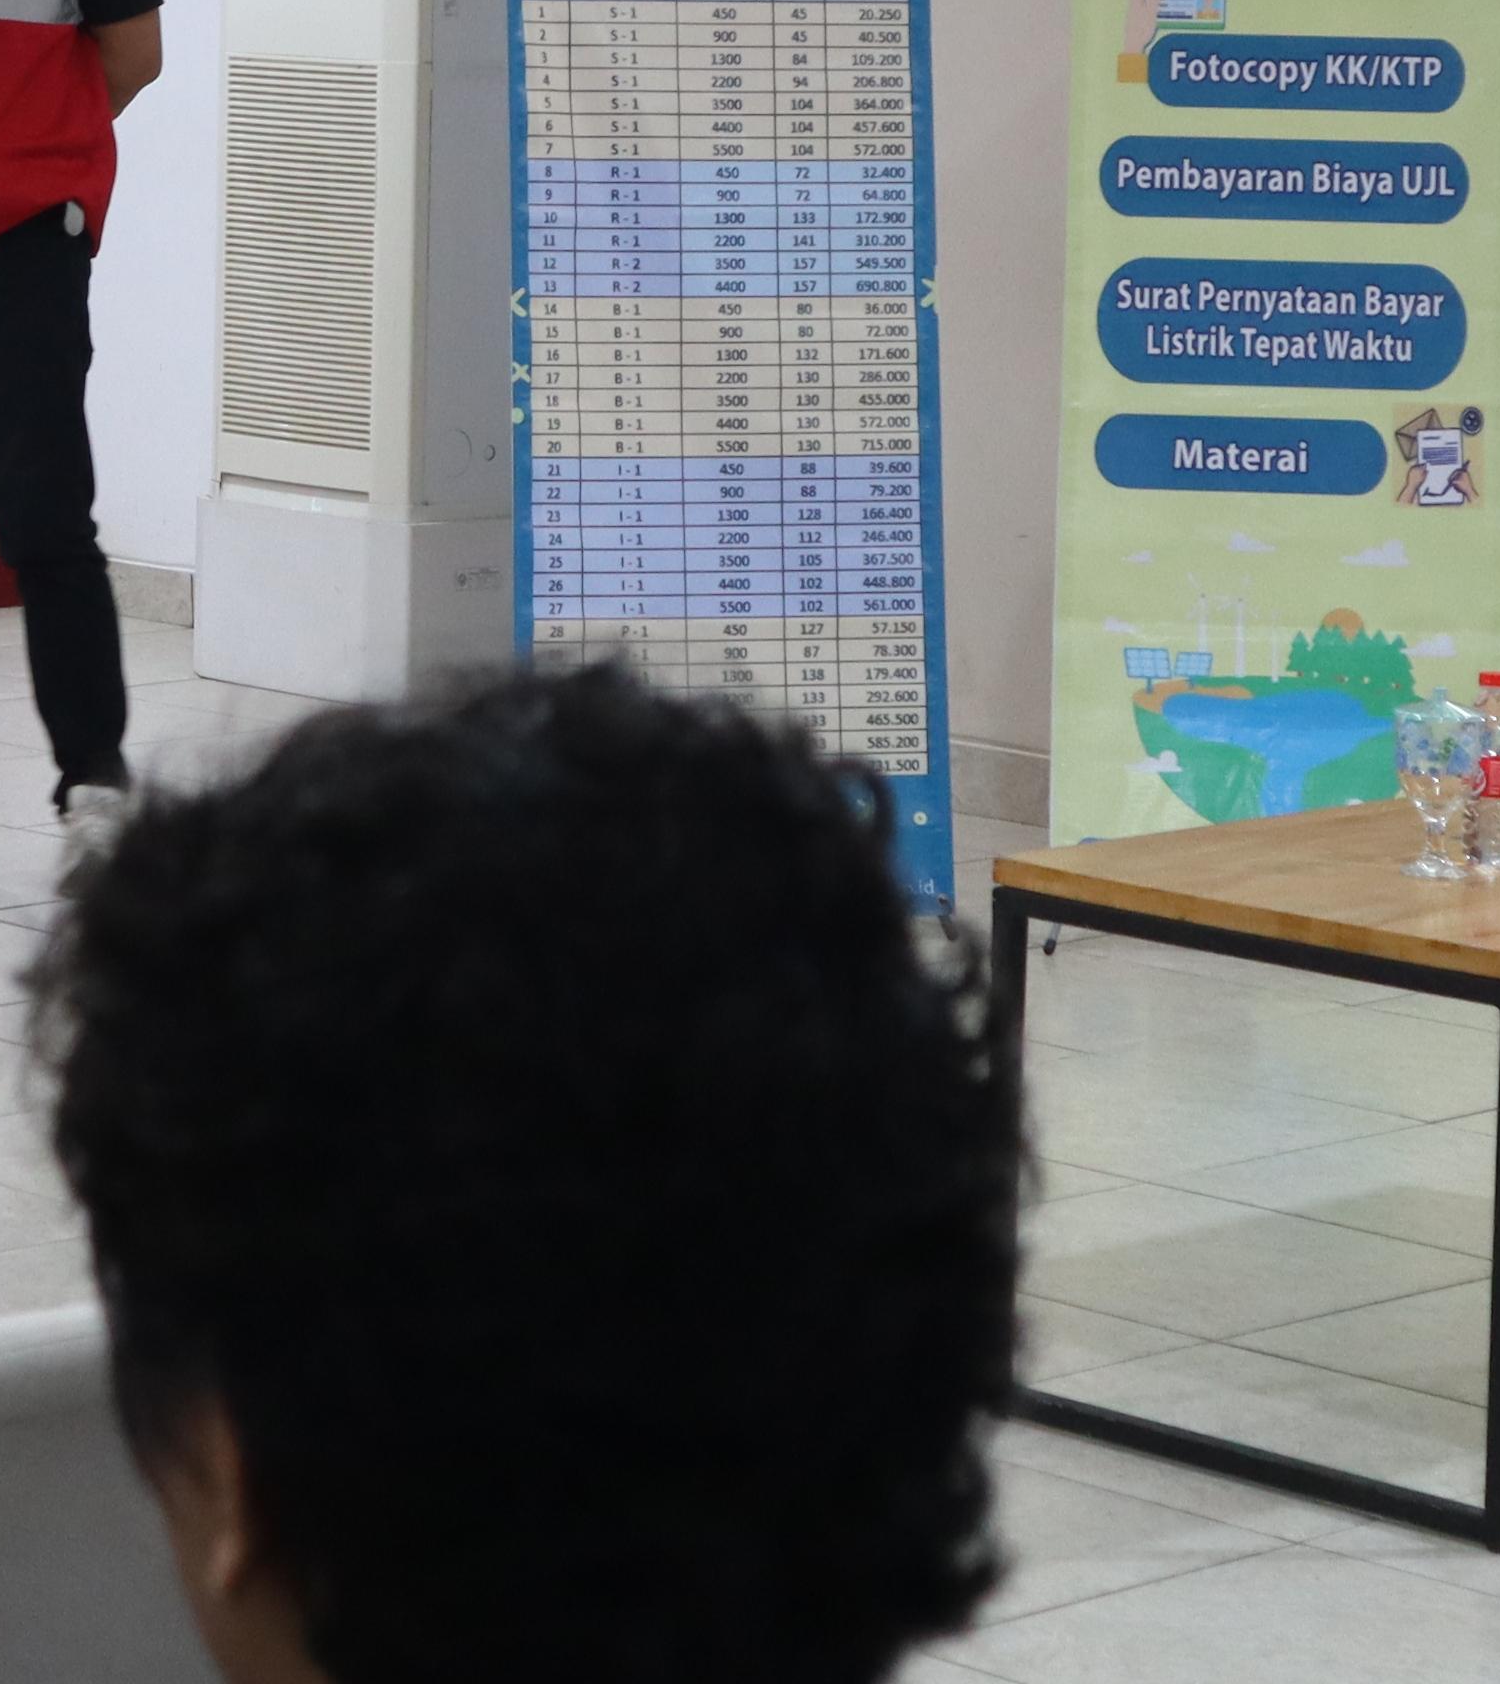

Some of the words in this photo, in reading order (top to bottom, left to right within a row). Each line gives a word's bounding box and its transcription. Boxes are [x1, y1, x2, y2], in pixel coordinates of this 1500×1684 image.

[713, 8, 736, 19] 450
[792, 9, 807, 19] 45
[860, 9, 901, 20] 20.250
[712, 54, 741, 65] 1300
[793, 54, 807, 65] 84
[853, 54, 902, 66] 109.200
[1170, 50, 1318, 92] Fotocopy
[1325, 54, 1443, 87] KK/KTP
[712, 76, 742, 88] 2200
[793, 77, 808, 87] 94
[854, 76, 903, 87] 206.800
[714, 99, 742, 110] 3500
[792, 99, 813, 110] 104
[855, 99, 903, 110] 364.000
[713, 145, 743, 156] 5500
[792, 145, 813, 156] 104
[855, 144, 905, 156] 572.000
[716, 167, 739, 179] 450
[796, 167, 809, 179] 72
[863, 167, 905, 178] 32.400
[1117, 158, 1304, 198] Pembayaran
[1312, 162, 1393, 203] Biaya
[1402, 165, 1456, 197] UJL
[716, 213, 745, 224] 1300
[794, 212, 815, 224] 133
[857, 212, 906, 223] 172.900
[715, 235, 745, 247] 2200
[794, 235, 815, 246] 141
[857, 235, 905, 246] 310.200
[715, 281, 745, 292] 4400
[795, 281, 816, 292] 157
[856, 281, 906, 292] 690.800
[1116, 278, 1191, 311] Surat
[1198, 281, 1357, 321] Pernyataan
[1364, 285, 1445, 325] Bayar
[720, 327, 742, 338] 900
[798, 326, 813, 337] 80
[867, 326, 908, 337] 72.000
[1146, 325, 1235, 357] Listrik
[1241, 327, 1318, 367] Tepat
[1325, 329, 1413, 363] Waktu
[717, 349, 747, 361] 1300
[797, 349, 818, 360] 132
[860, 348, 909, 360] 171.600
[718, 395, 748, 407] 3500
[797, 395, 819, 406] 130
[859, 394, 910, 405] 455.000
[717, 441, 748, 452] 5500
[798, 440, 821, 451] 130
[862, 439, 911, 450] 715.000
[1173, 439, 1309, 473] Materai
[720, 486, 744, 498] 900
[801, 486, 816, 497] 88
[870, 485, 911, 496] 79.200
[718, 510, 749, 521] 1300
[799, 509, 821, 520] 128
[863, 508, 912, 519] 166.400
[719, 532, 749, 544] 2200
[800, 532, 821, 543] 112
[863, 530, 912, 542] 246.400
[719, 578, 750, 590] 4400
[800, 578, 822, 589] 102
[863, 576, 915, 588] 448.800
[723, 624, 747, 636] 450
[801, 623, 823, 635] 127
[873, 622, 916, 633] 57.150
[724, 647, 747, 659] 900
[804, 646, 819, 658] 87
[874, 645, 916, 656] 78.300
